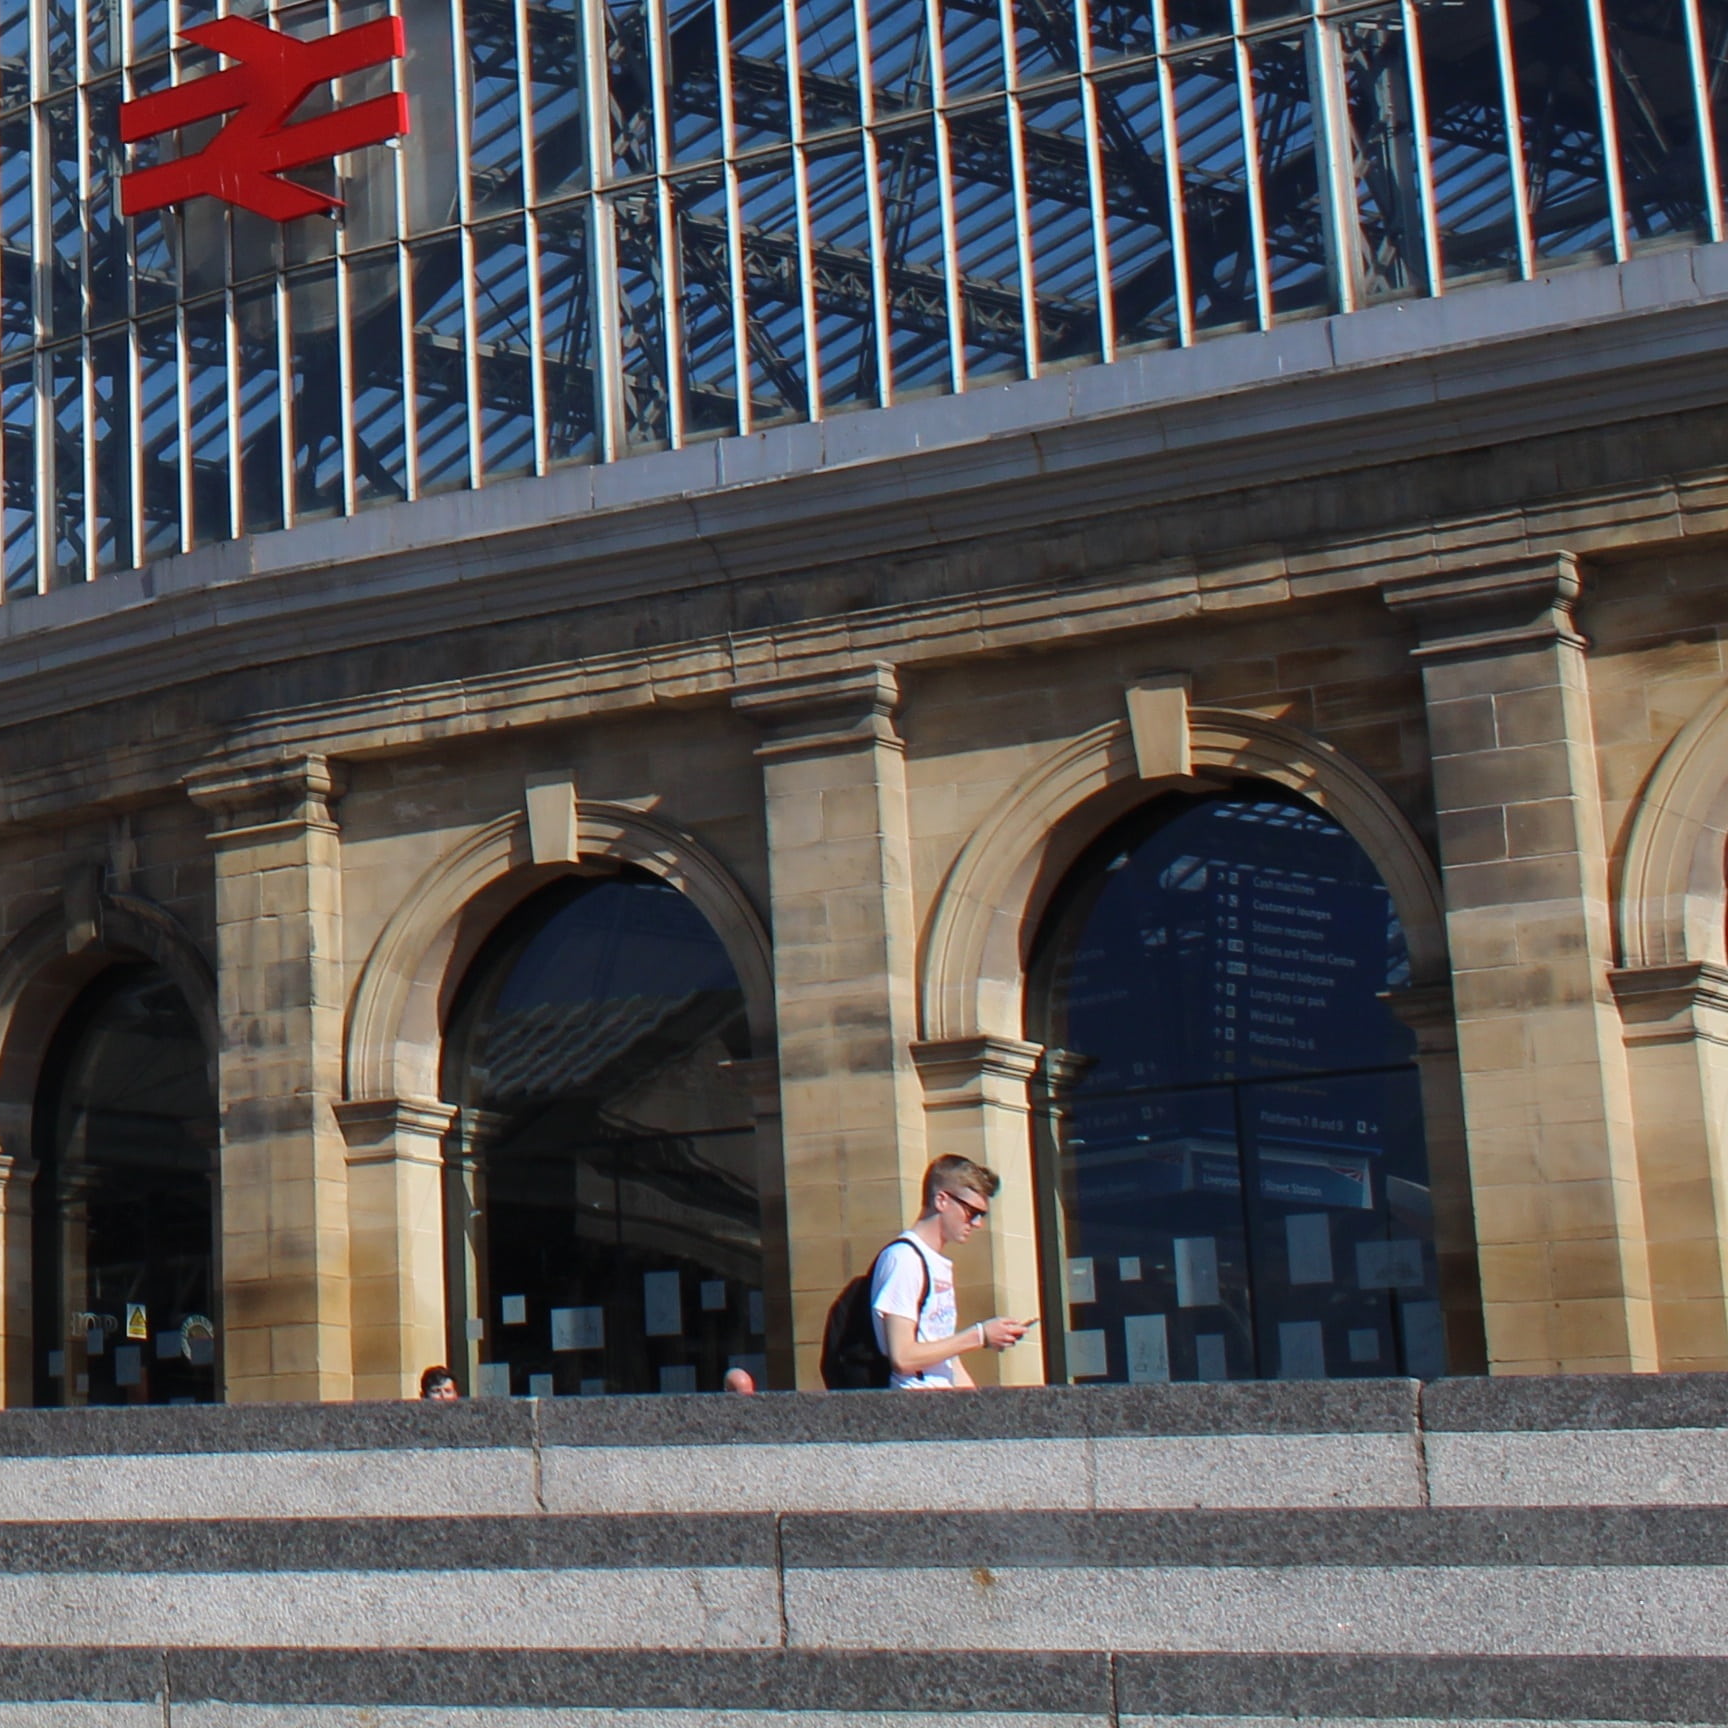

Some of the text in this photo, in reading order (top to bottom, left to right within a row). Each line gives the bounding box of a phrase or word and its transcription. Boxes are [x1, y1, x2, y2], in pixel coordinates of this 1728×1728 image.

[1252, 899, 1332, 921] Customer lounges
[1251, 942, 1356, 968] Tickets and Travel Centre
[1260, 1110, 1301, 1128] Platforms
[1264, 1178, 1290, 1194] Street
[1291, 1182, 1322, 1198] Station
